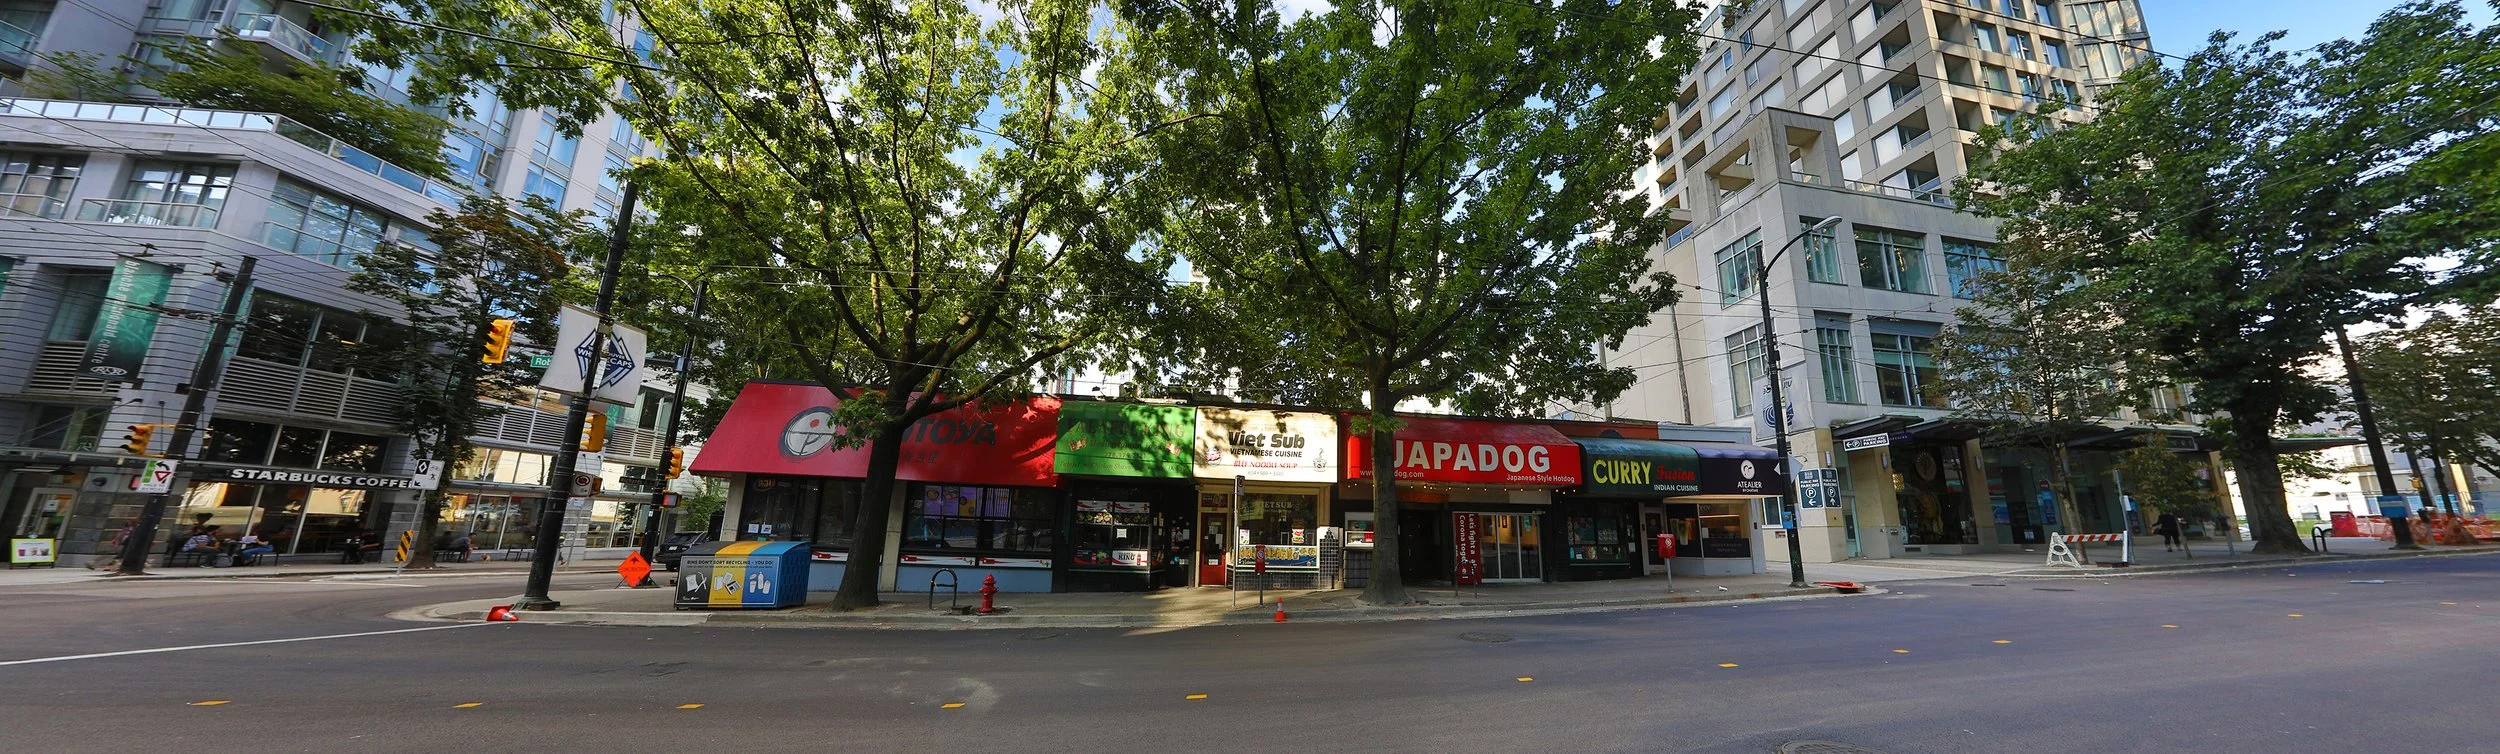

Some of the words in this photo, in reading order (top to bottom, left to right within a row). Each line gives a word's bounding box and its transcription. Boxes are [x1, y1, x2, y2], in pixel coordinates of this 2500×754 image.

[118, 260, 141, 292] blanche
[90, 338, 112, 364] centre
[901, 418, 996, 447] TOYA
[1228, 430, 1267, 448] Viet
[1270, 433, 1305, 449] Sub
[1230, 448, 1273, 457] VIETNAMESE
[1274, 450, 1303, 458] CUISINE
[1393, 439, 1550, 473] JAPADOG
[231, 468, 352, 486] STARBUCKS
[355, 476, 413, 489] COFFE
[1506, 474, 1536, 482] Japanese
[1536, 475, 1552, 483] Style
[1553, 475, 1575, 484] Hotdog
[1592, 459, 1652, 485] CURRY
[1656, 464, 1696, 481] Fusion
[1654, 484, 1675, 492] INDIAN
[1676, 484, 1699, 492] CUISINE
[1118, 553, 1136, 561] KING
